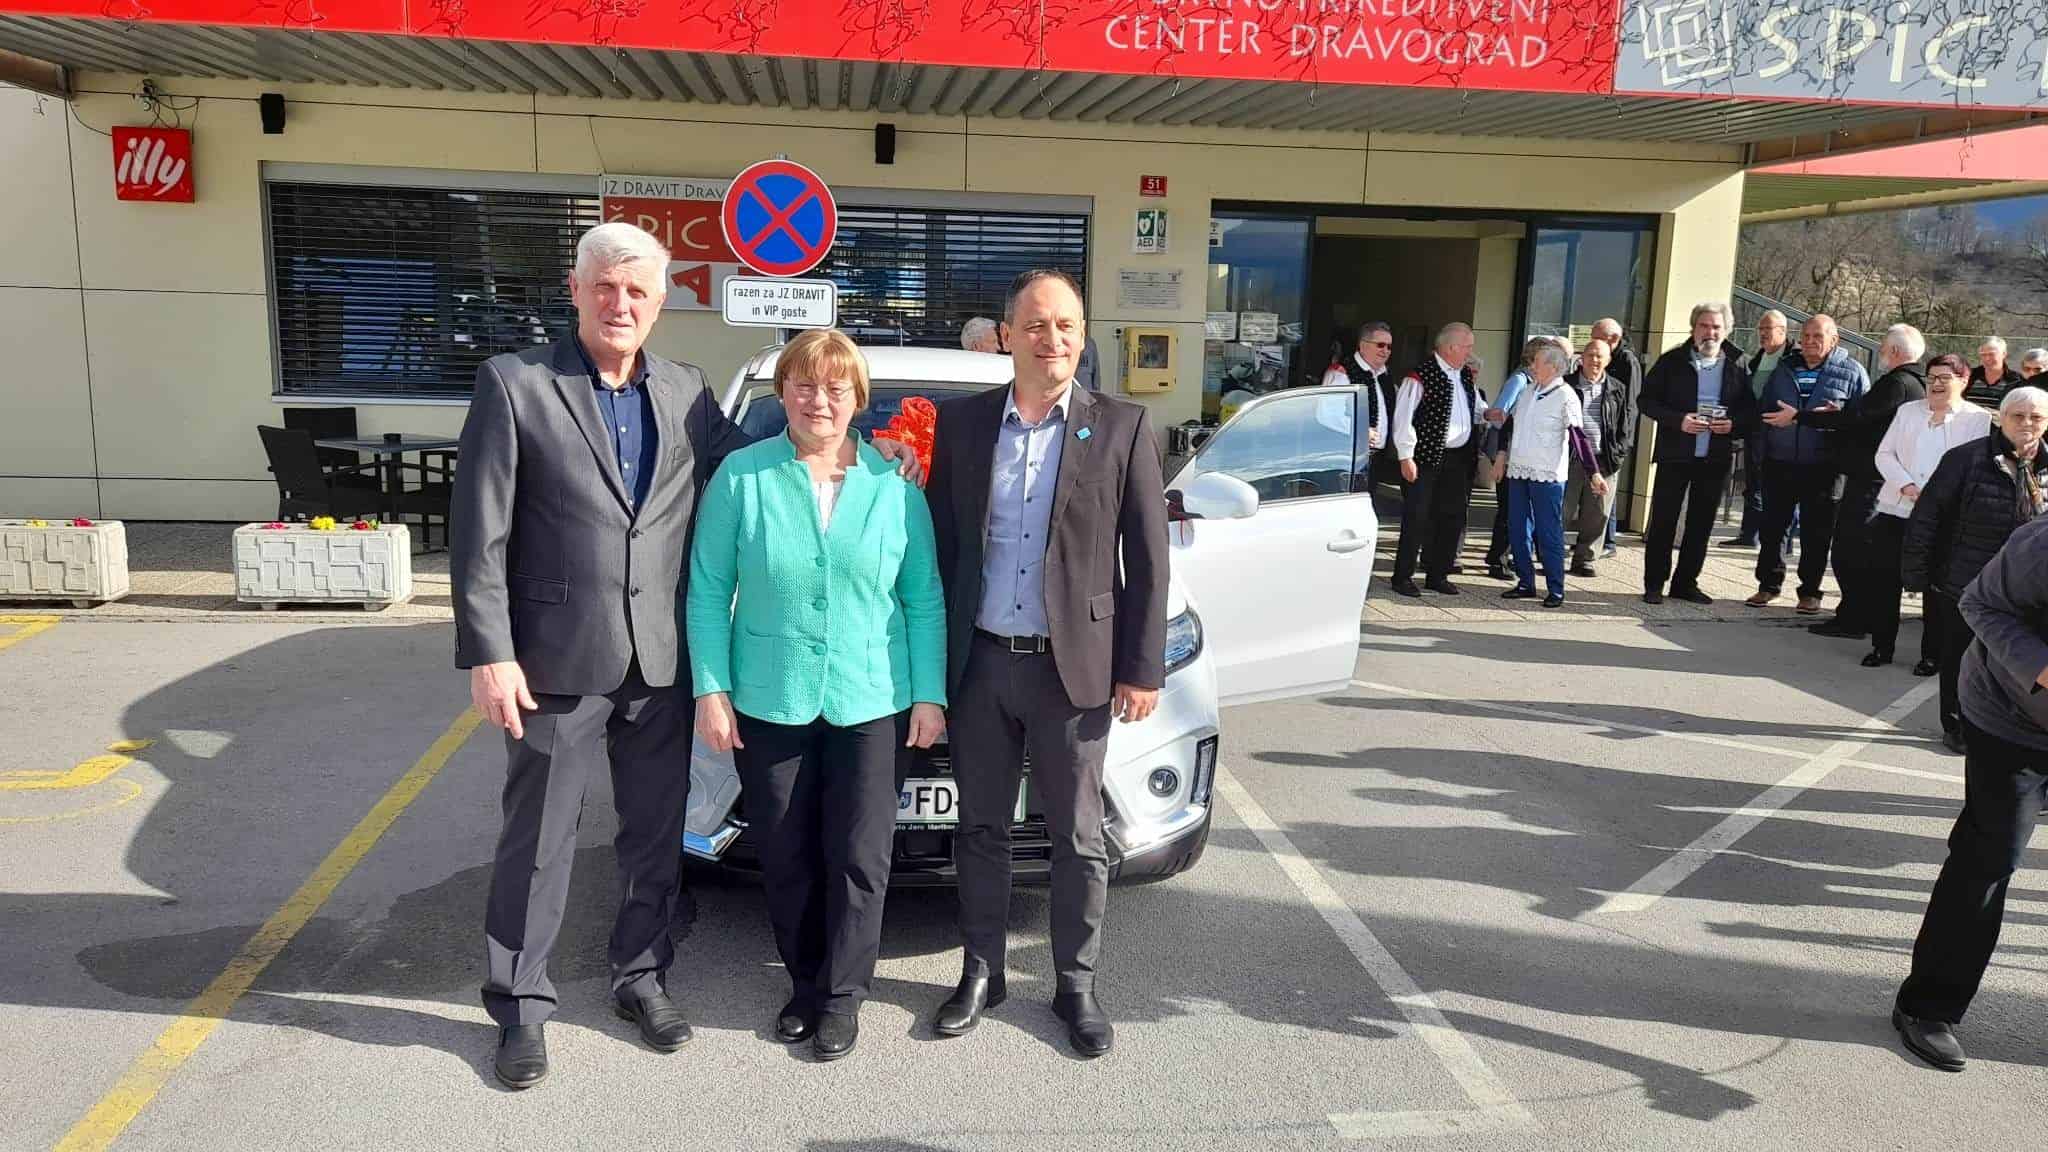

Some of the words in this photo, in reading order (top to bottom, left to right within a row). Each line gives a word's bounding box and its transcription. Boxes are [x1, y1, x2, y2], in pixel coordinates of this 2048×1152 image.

[1105, 14, 1262, 54] CENTER
[1290, 23, 1547, 68] DRAVOGRAD
[117, 136, 186, 196] illy
[603, 181, 618, 194] JZ
[624, 181, 680, 196] DRAVIT
[1147, 178, 1160, 189] 51
[1137, 237, 1153, 247] AED
[733, 287, 760, 297] razen
[764, 289, 774, 298] za
[778, 288, 790, 299] JZ
[793, 288, 825, 301] DRAVIT
[752, 304, 760, 315] in
[764, 304, 779, 316] VIP
[781, 306, 807, 319] goste
